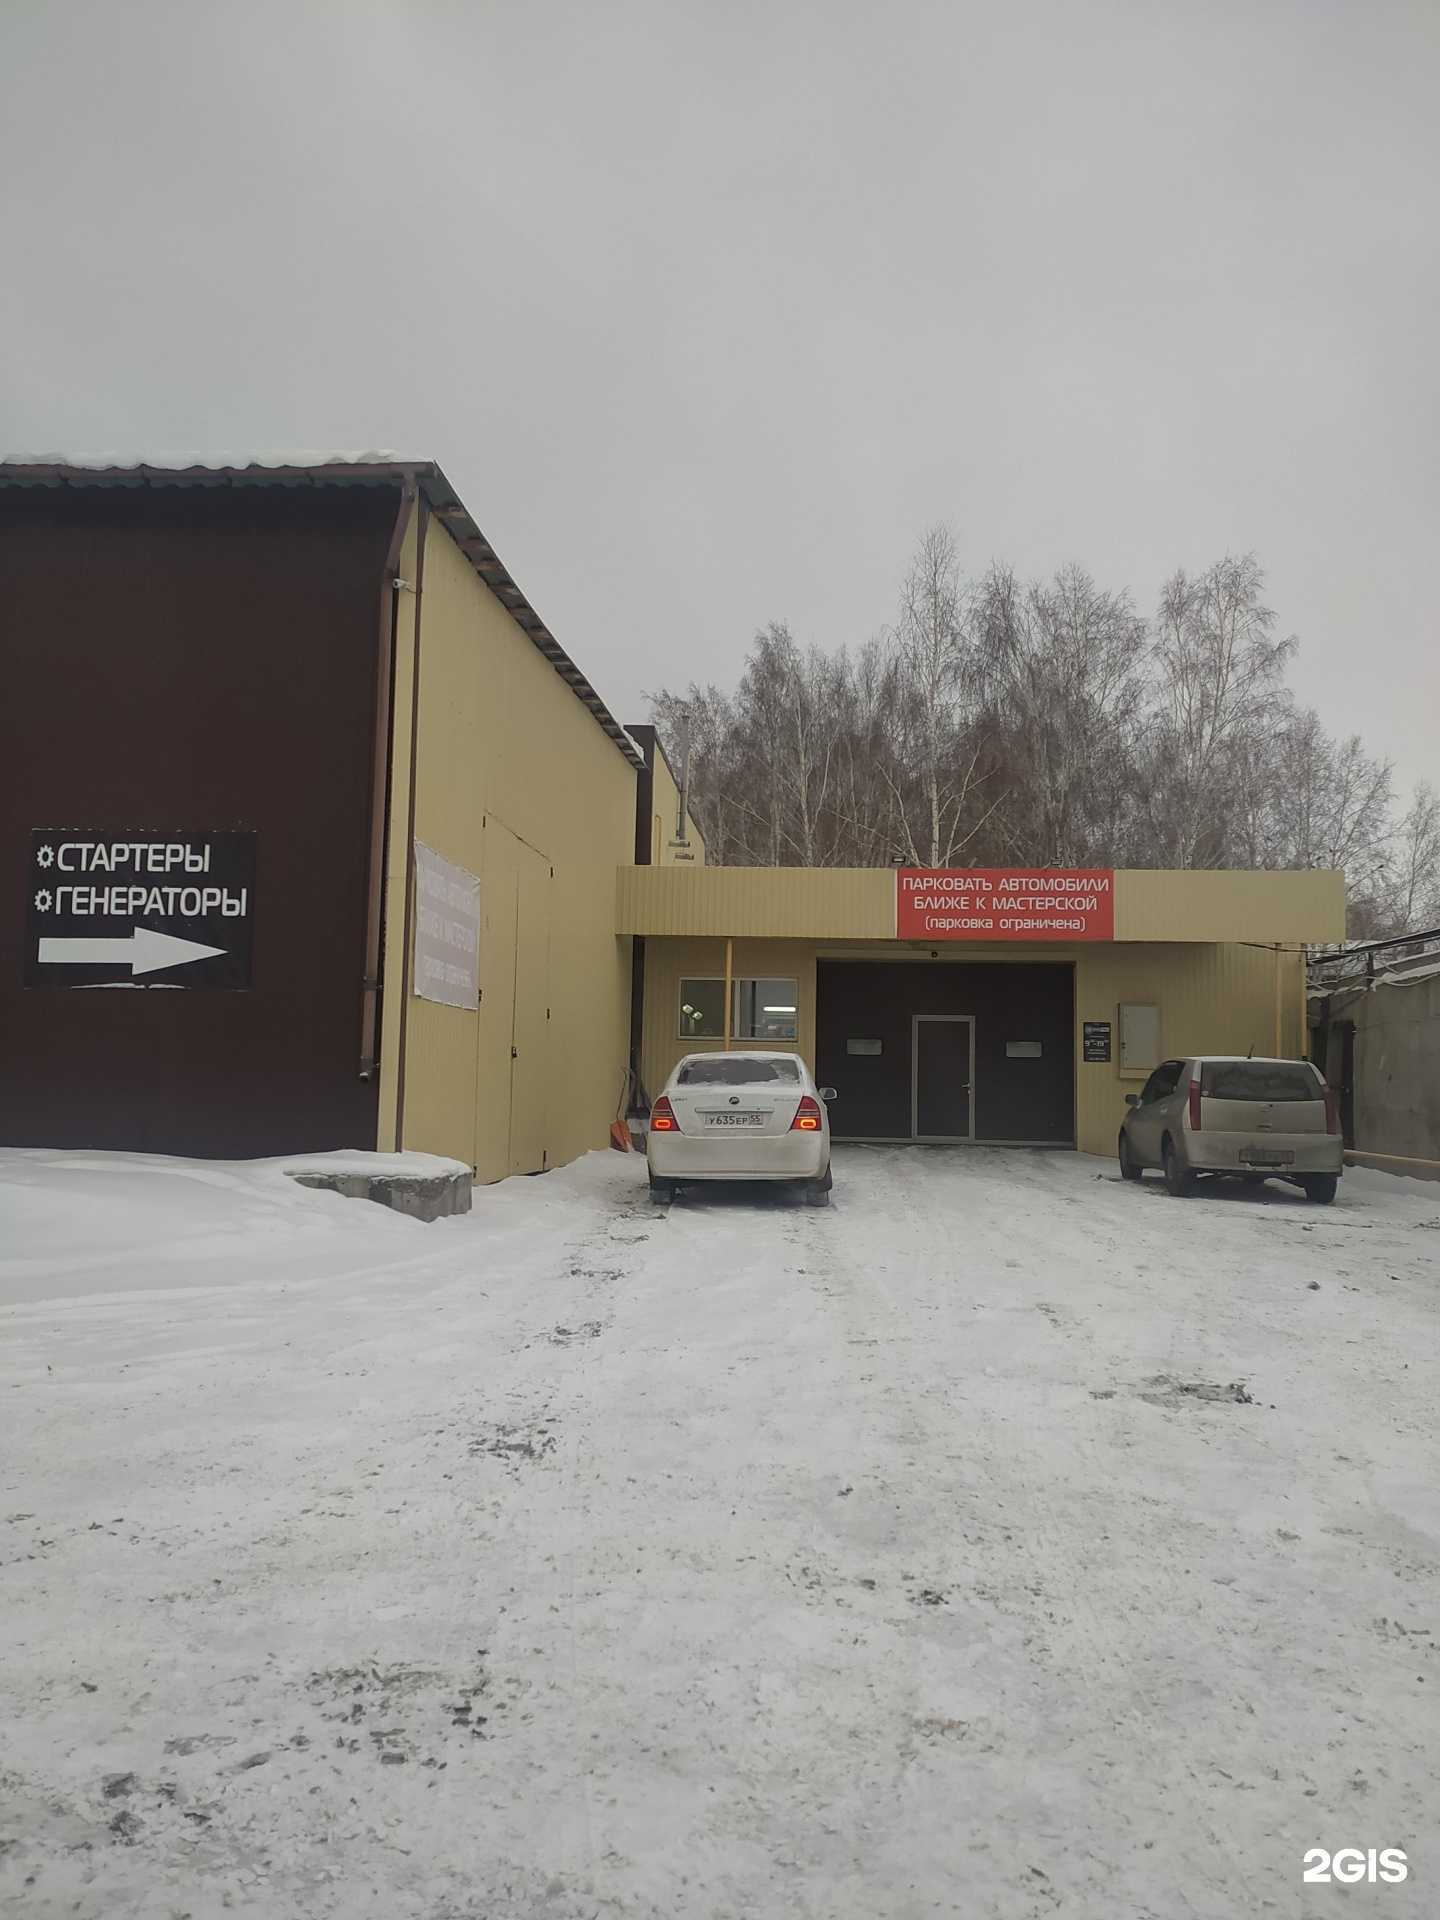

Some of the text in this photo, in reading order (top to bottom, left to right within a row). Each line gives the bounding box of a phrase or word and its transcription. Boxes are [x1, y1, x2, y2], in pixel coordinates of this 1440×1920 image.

[57, 843, 211, 873] СТАРТЕРЫ
[903, 877, 1110, 892] ПАРКОВАТЬ АВТОМОБИЛИ
[55, 886, 248, 917] ГЕНЕРАТОРЫ
[914, 895, 1098, 911] БЛИЖЕ К МАСТЕРСКОЙ
[925, 916, 1087, 932] (парковка ограничена)
